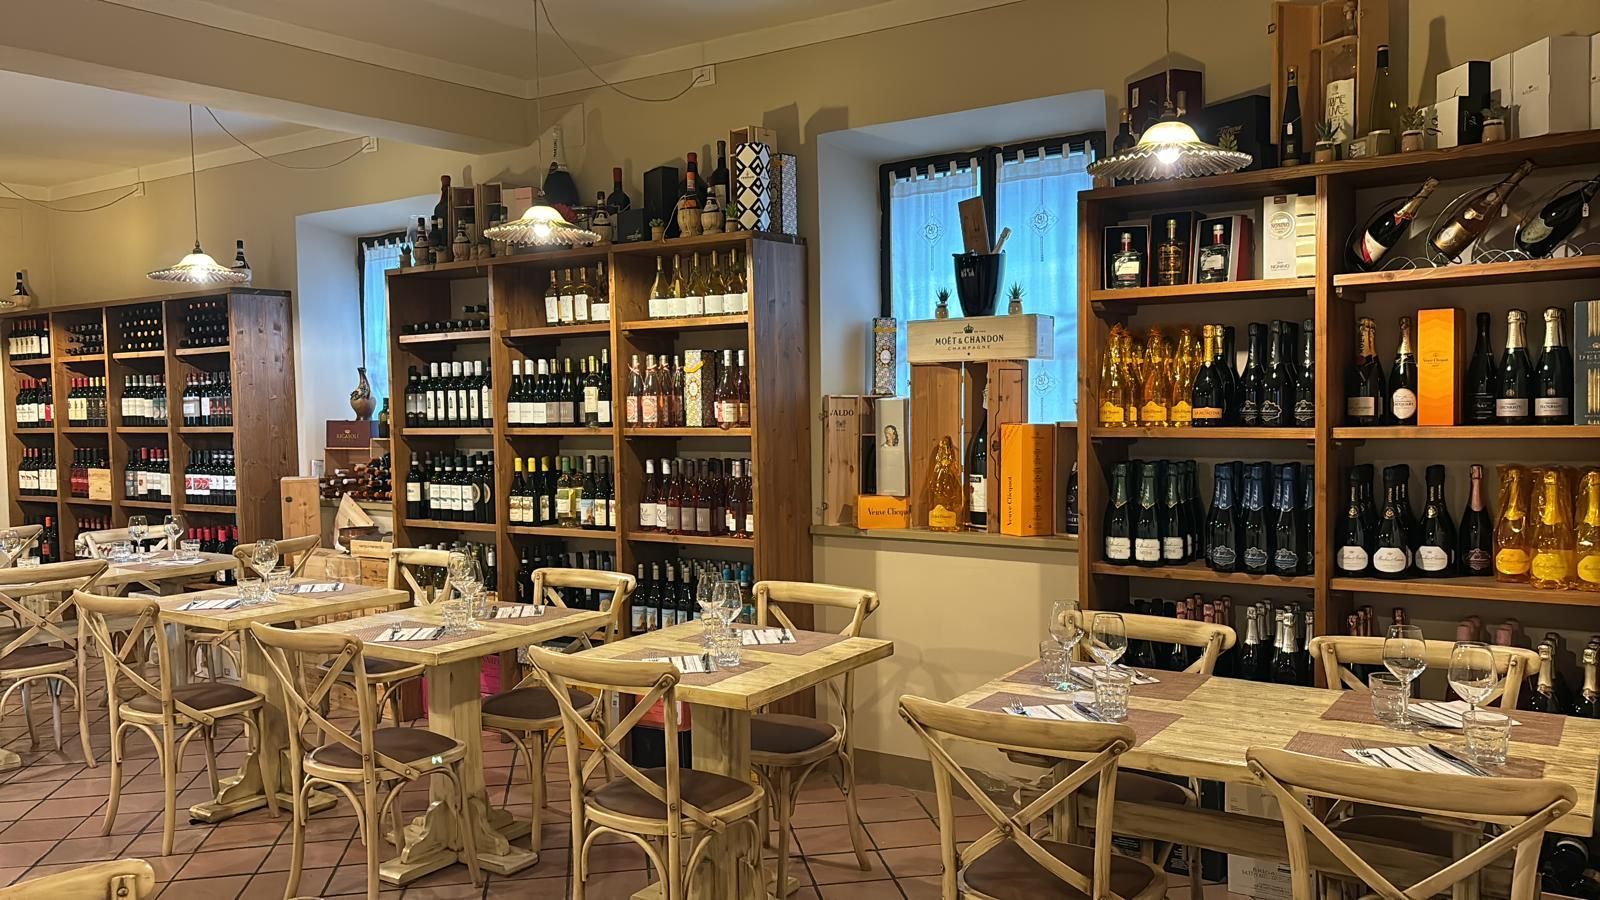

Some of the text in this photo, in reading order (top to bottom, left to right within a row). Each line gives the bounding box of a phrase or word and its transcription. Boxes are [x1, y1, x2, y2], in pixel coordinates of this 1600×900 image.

[935, 334, 1004, 346] MOËT & CHANDON
[867, 507, 911, 517] Veuve Clicquo
